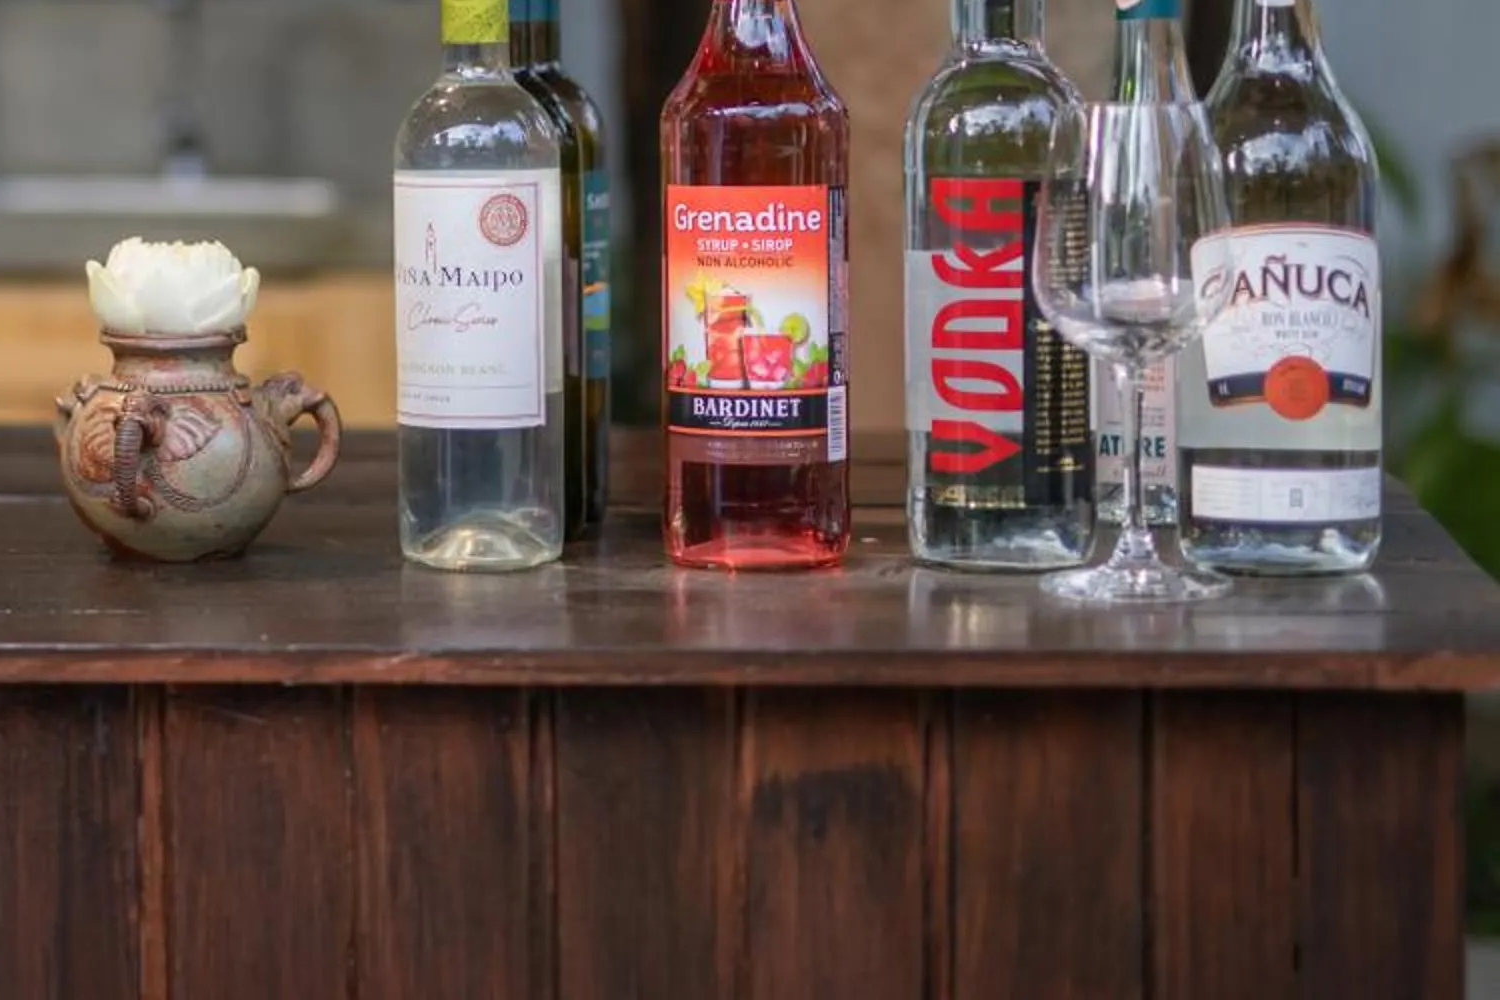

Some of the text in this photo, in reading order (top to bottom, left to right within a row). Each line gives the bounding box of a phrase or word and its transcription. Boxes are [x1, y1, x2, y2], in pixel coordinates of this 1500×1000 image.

[674, 202, 821, 231] Grenadine
[697, 238, 793, 251] SYRUP SIROP
[697, 256, 795, 268] NON ALCOHOLIC
[1201, 254, 1369, 319] CAÑUCA
[931, 178, 1024, 473] VODKA
[693, 397, 803, 418] BARDINET
